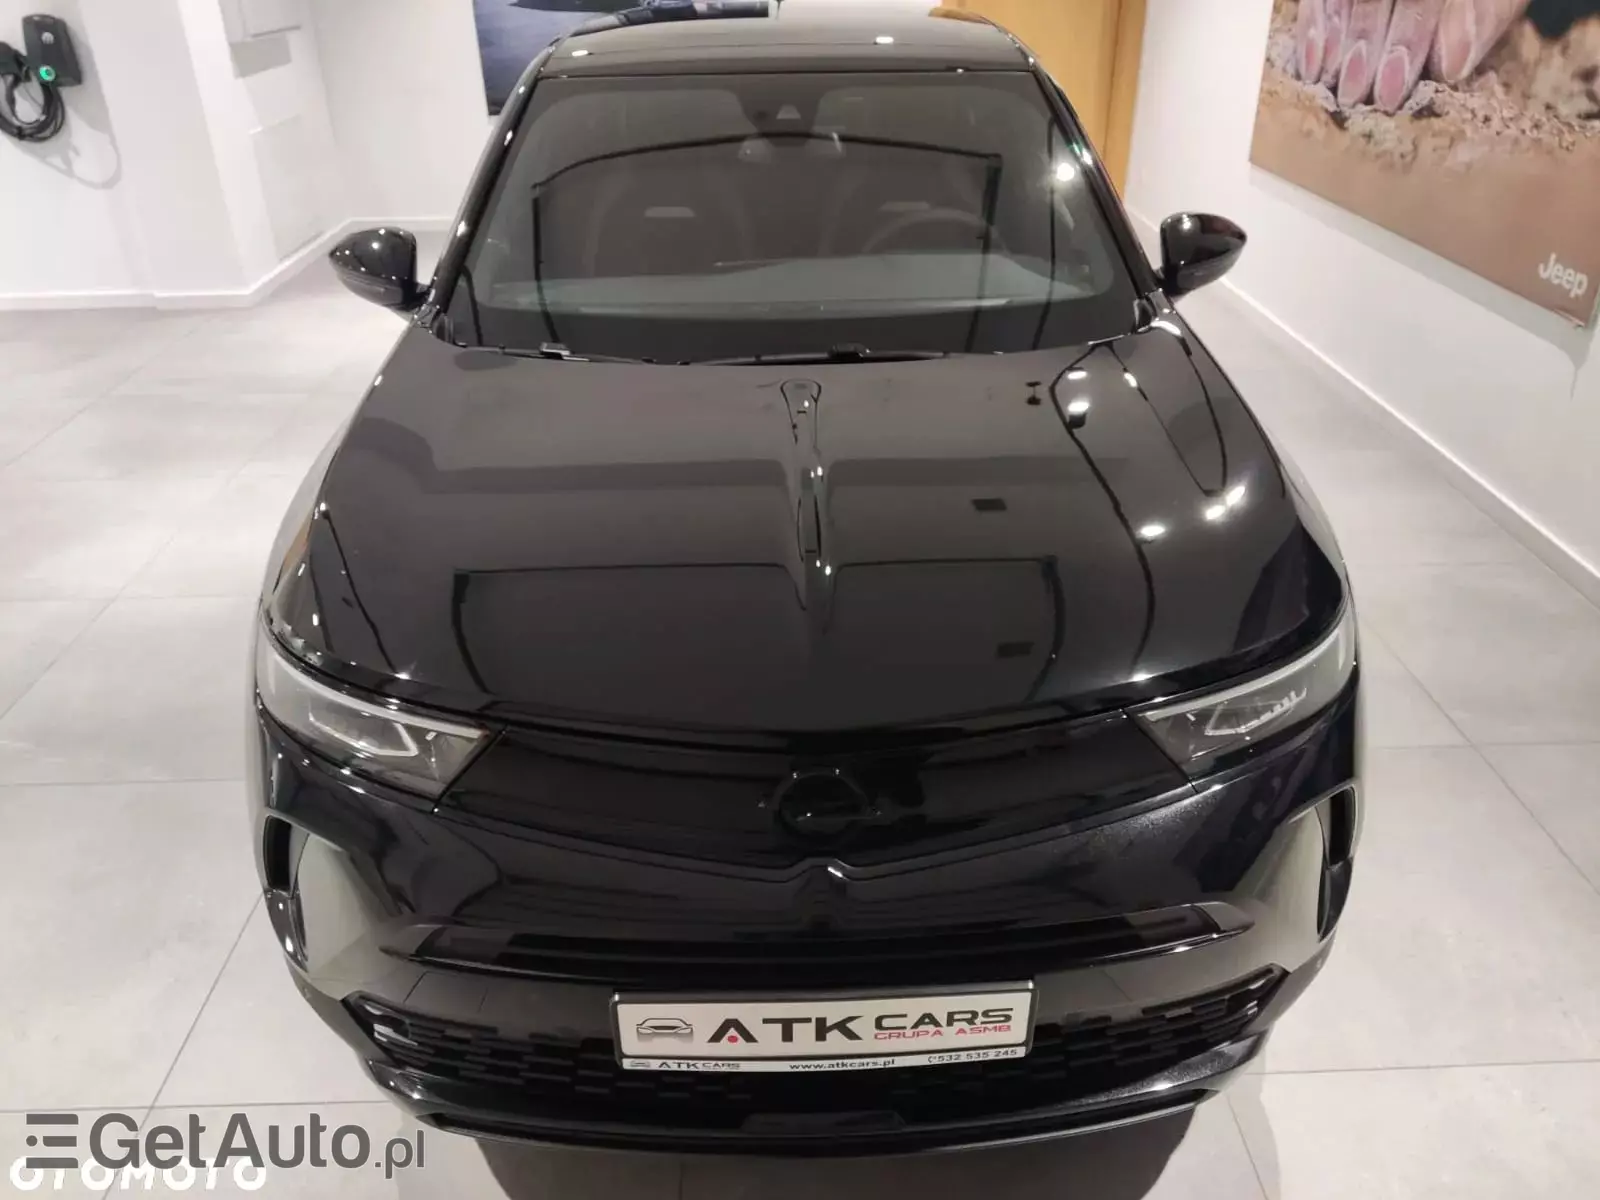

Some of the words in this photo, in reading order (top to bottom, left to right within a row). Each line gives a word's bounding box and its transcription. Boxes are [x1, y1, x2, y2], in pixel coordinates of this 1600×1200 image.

[1538, 252, 1588, 298] Jeep
[706, 1015, 863, 1043] ATK
[874, 1007, 1014, 1031] CARS
[874, 1029, 944, 1041] GRUPA
[954, 1024, 1012, 1036] ASMB
[658, 1061, 699, 1070] ATK
[701, 1062, 741, 1070] CARS
[788, 1058, 896, 1070] www.atkcars.pl
